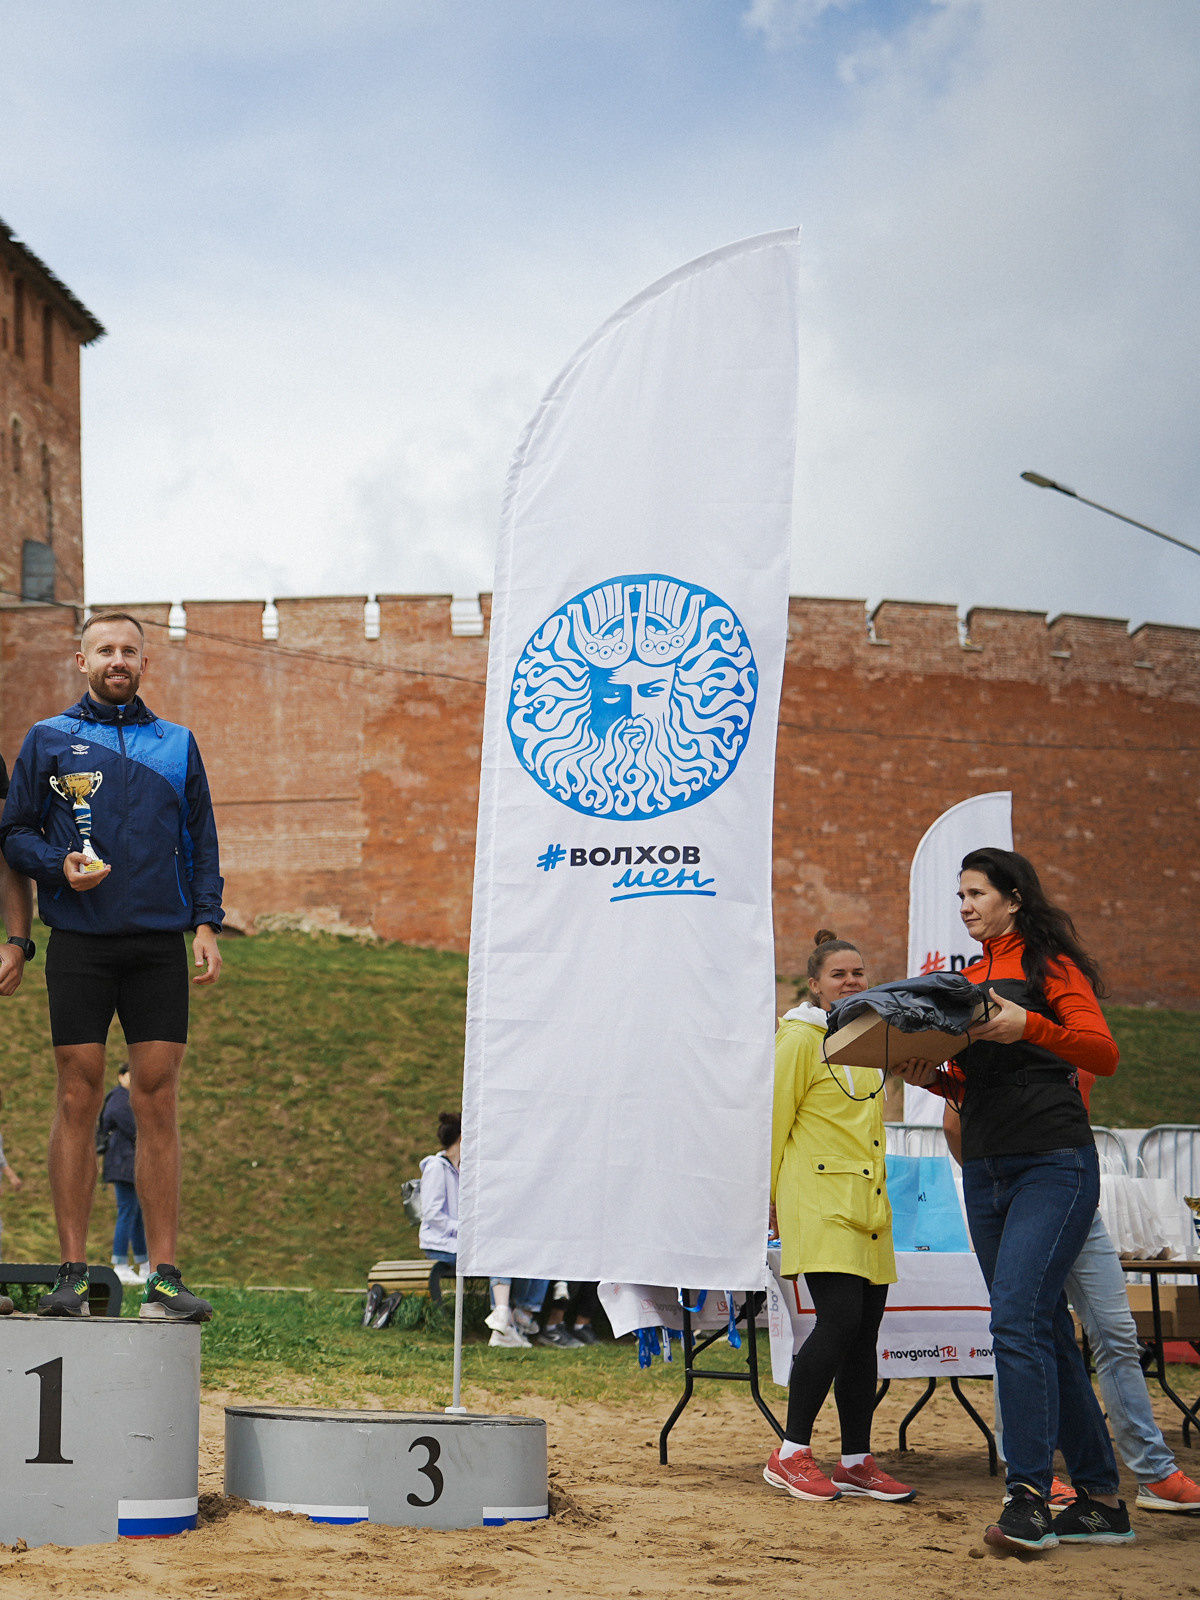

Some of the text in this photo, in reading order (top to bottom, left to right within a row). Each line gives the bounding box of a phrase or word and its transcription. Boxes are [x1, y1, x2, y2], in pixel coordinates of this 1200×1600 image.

[537, 844, 701, 871] #ВОЛХОВ
[611, 868, 716, 892] мен
[25, 1357, 73, 1464] 1
[407, 1436, 444, 1507] 3
